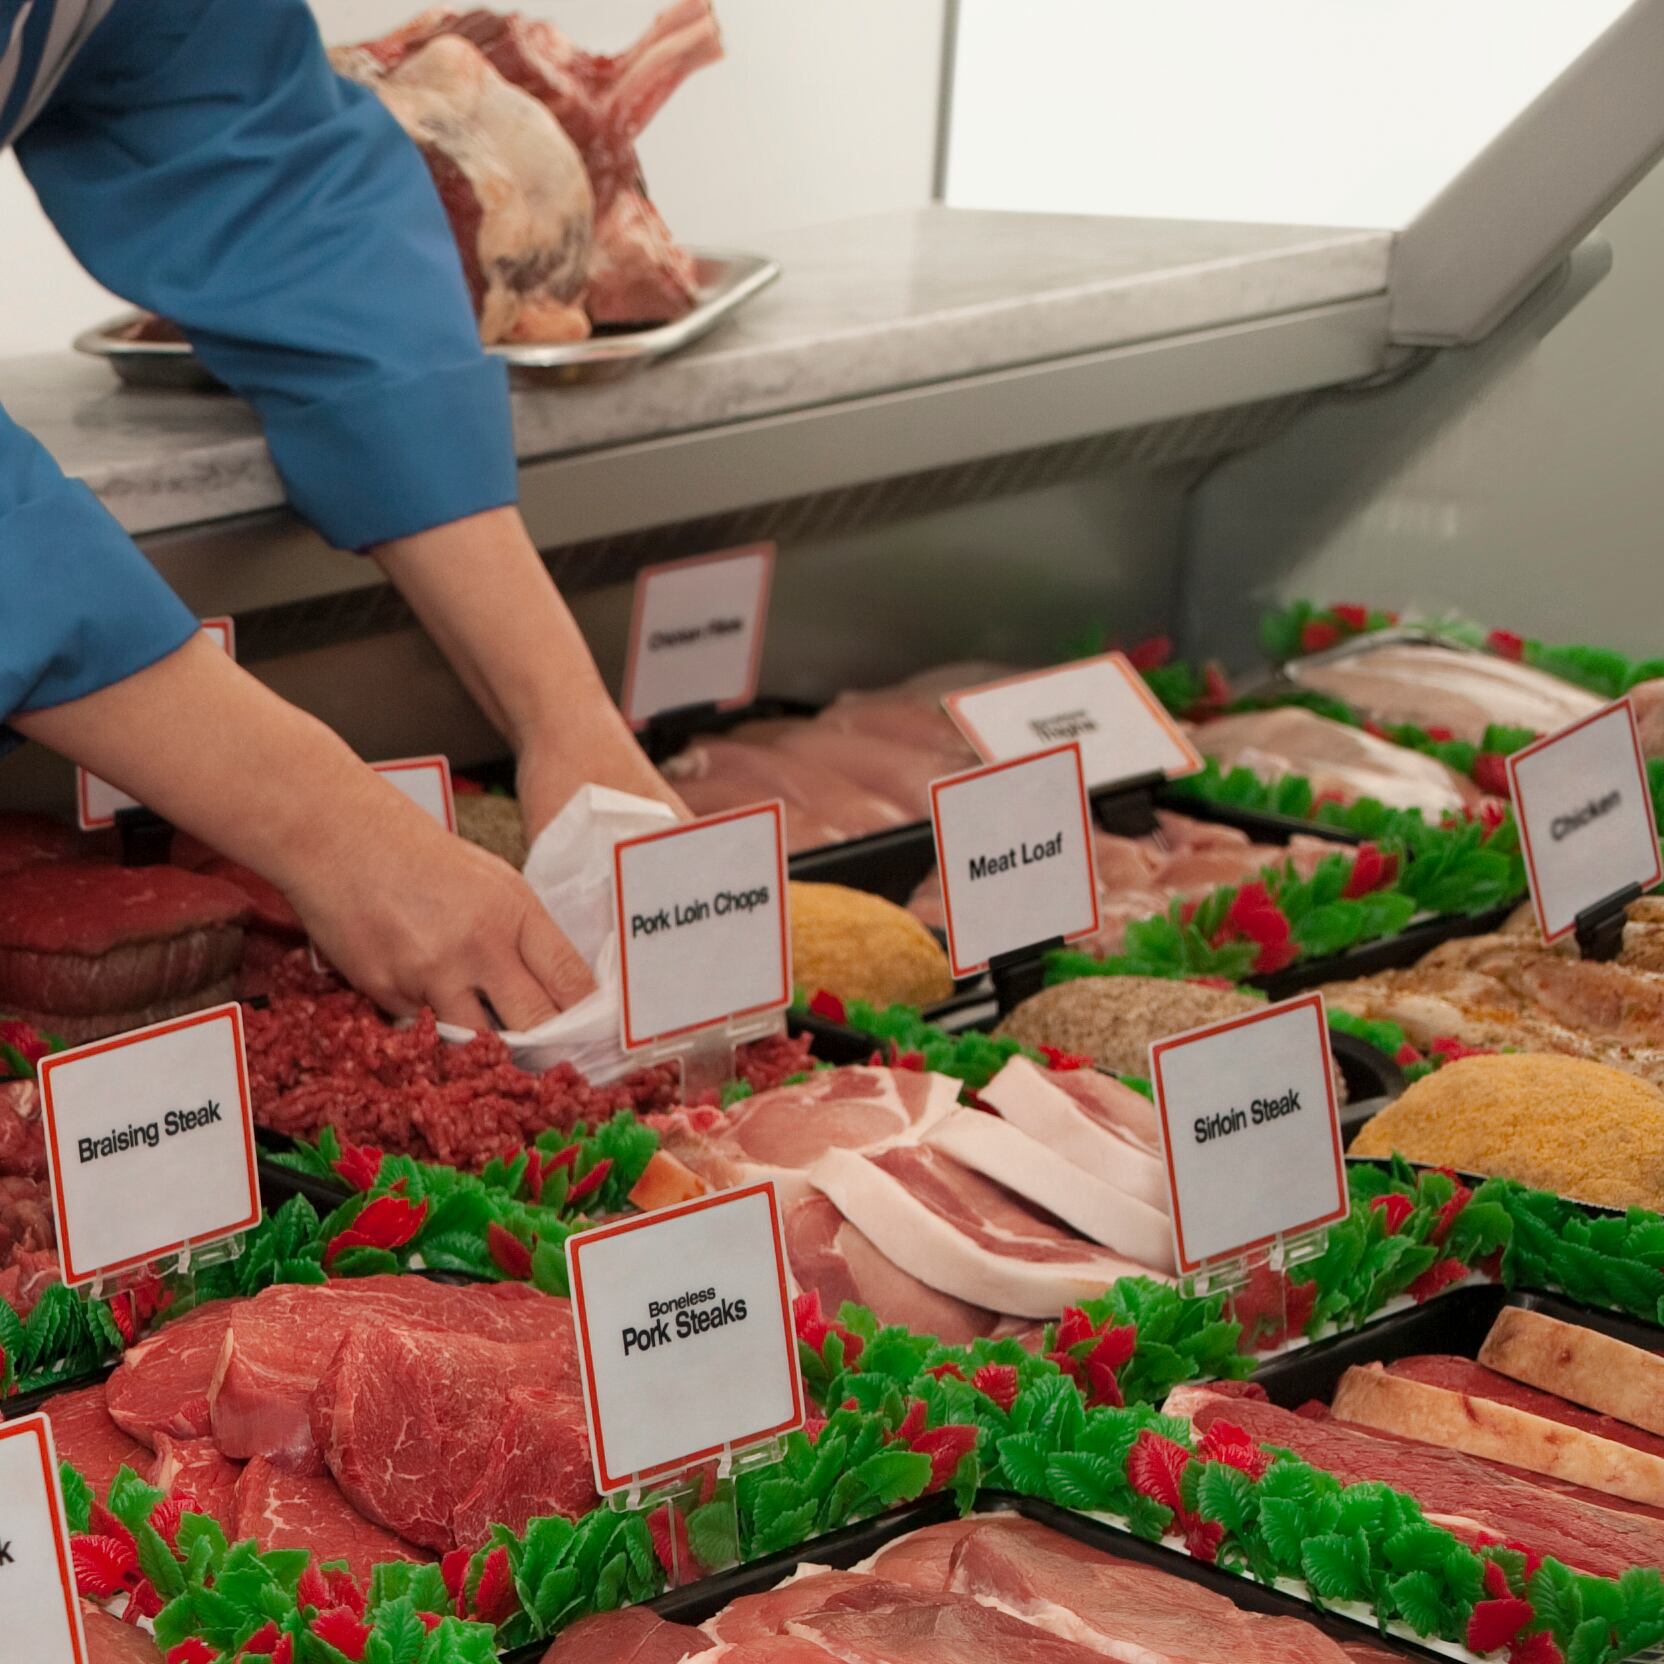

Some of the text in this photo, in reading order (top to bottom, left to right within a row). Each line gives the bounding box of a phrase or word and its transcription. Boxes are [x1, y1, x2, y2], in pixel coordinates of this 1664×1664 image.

[968, 831, 1063, 881] Meat Loaf
[631, 886, 770, 939] Pork Loin Chops
[77, 1099, 222, 1164] Braising Steak
[1193, 1088, 1302, 1144] Sirloin Steak
[621, 1297, 748, 1357] Pork Steaks
[648, 1287, 716, 1319] Boneless
